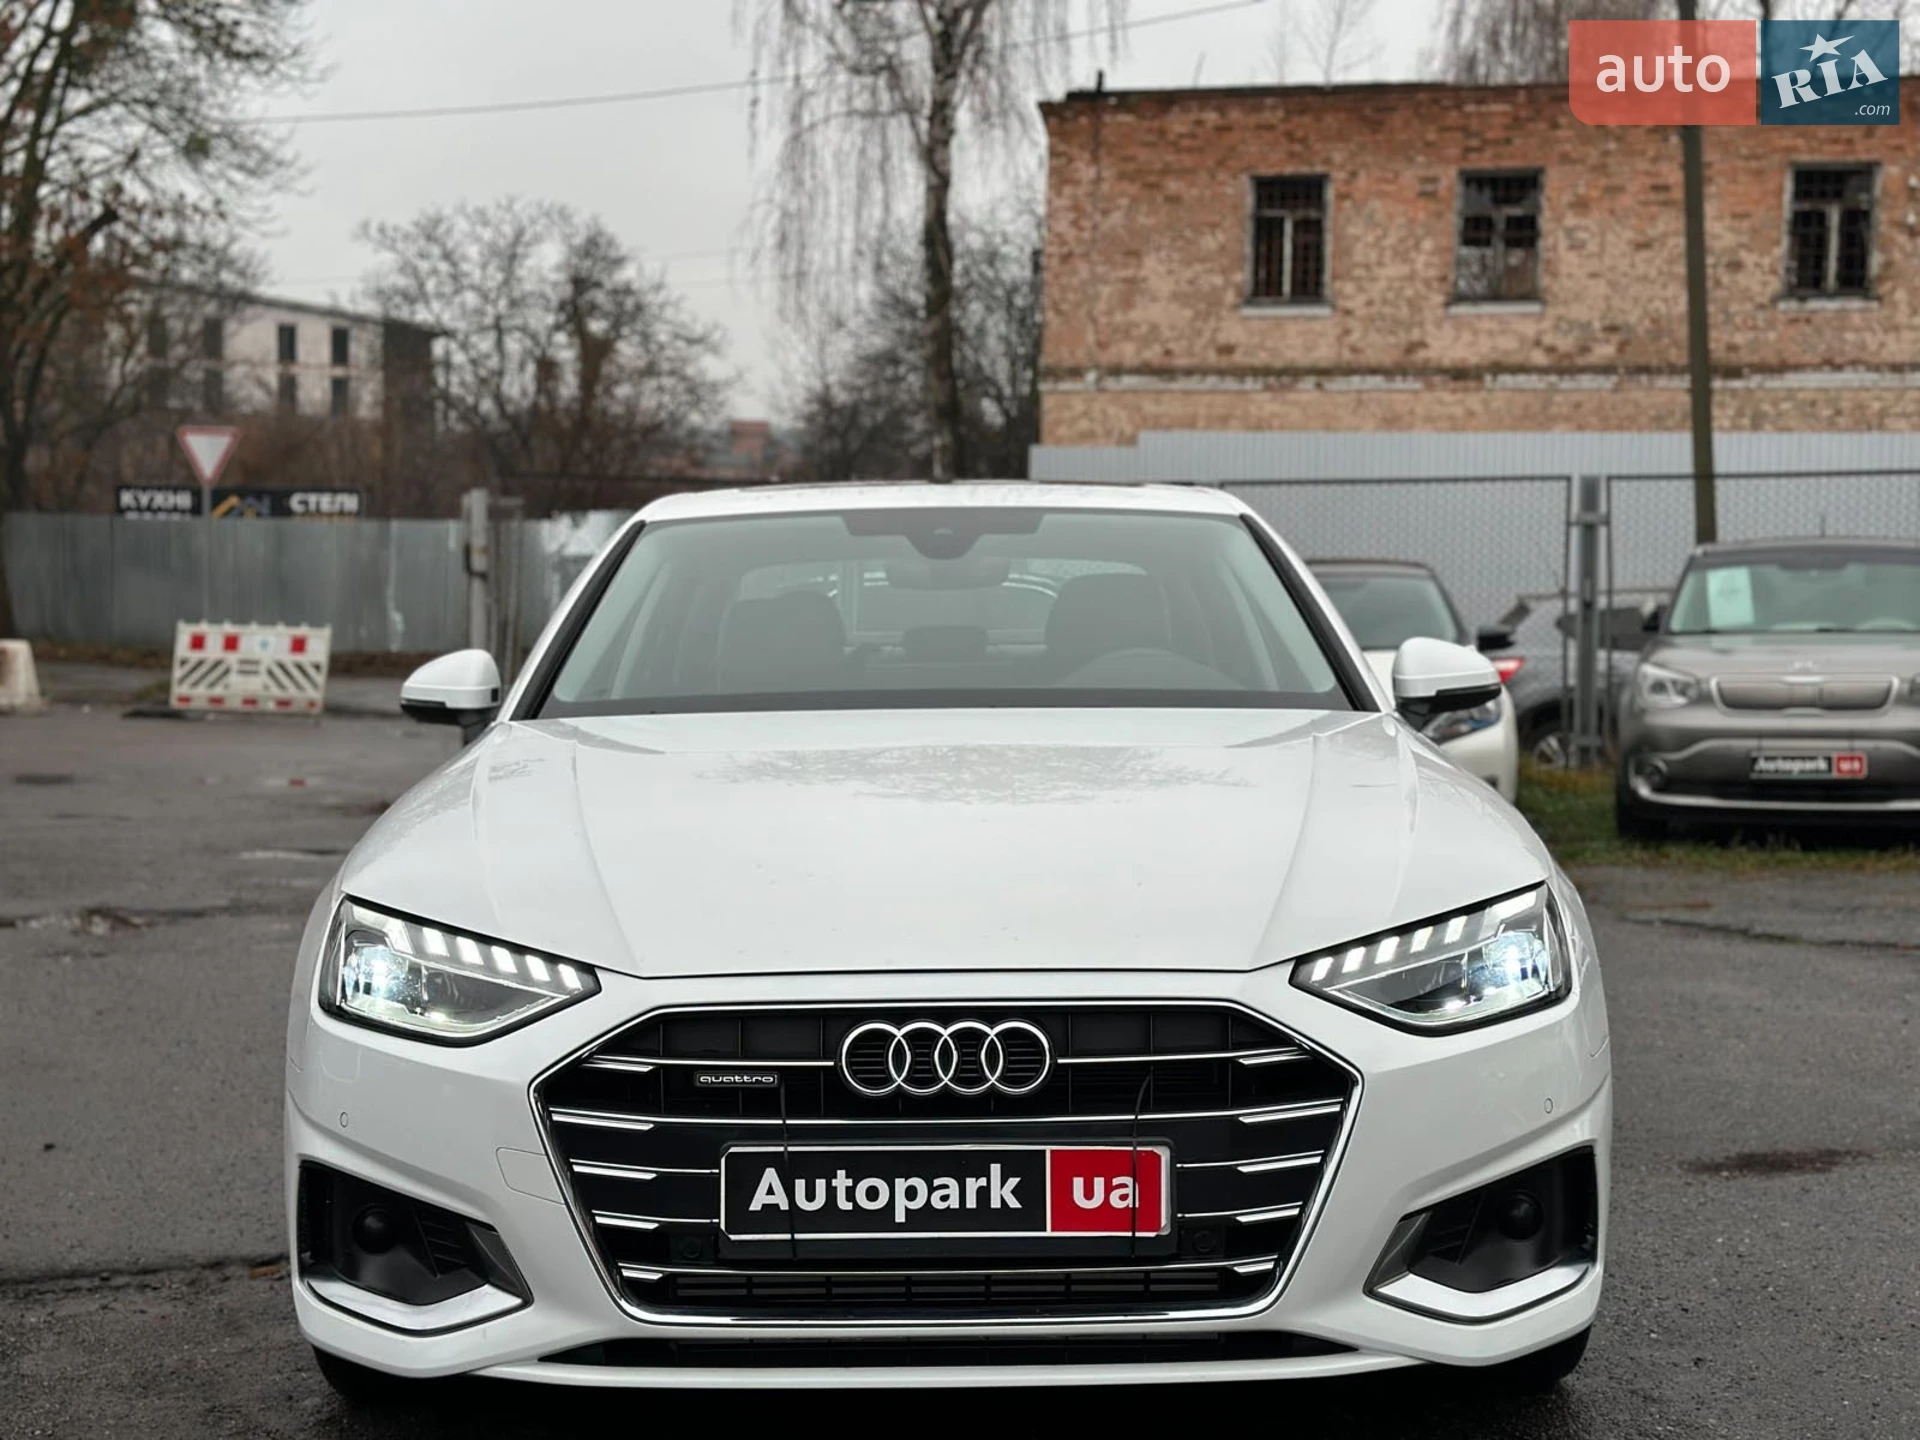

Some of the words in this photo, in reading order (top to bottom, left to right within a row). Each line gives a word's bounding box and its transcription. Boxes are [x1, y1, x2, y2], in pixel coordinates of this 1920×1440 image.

[699, 1074, 774, 1084] quattro
[748, 1163, 1022, 1223] Autopark
[1071, 1174, 1140, 1209] ua
